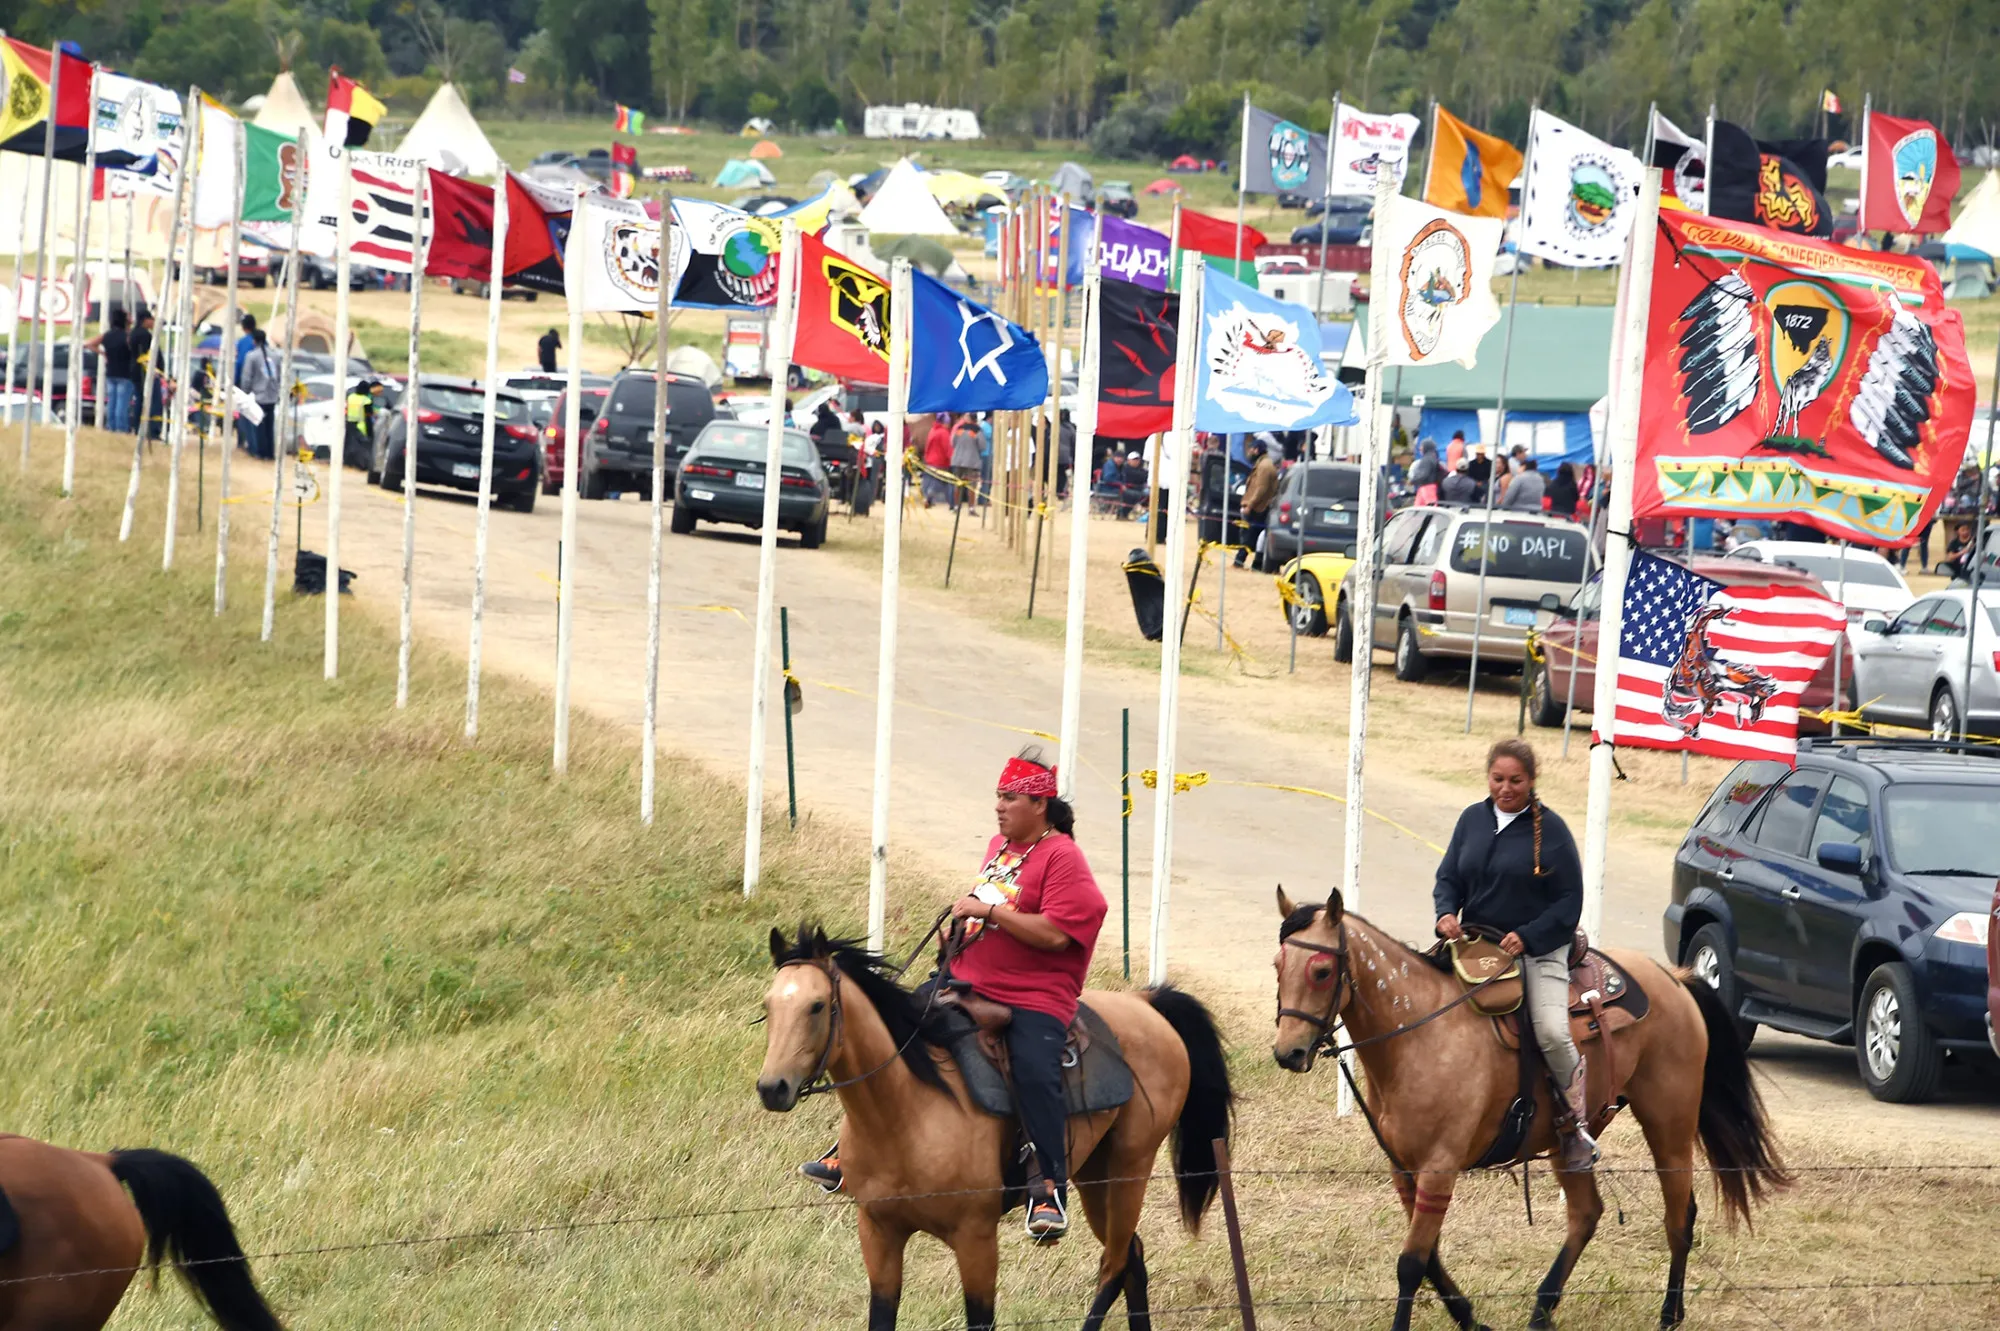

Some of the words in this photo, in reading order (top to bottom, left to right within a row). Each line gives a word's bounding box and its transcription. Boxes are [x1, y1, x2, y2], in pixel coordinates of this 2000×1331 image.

[1687, 225, 1769, 256] COLVILLE
[1784, 313, 1813, 329] 1872
[1521, 536, 1572, 560] DAPL
